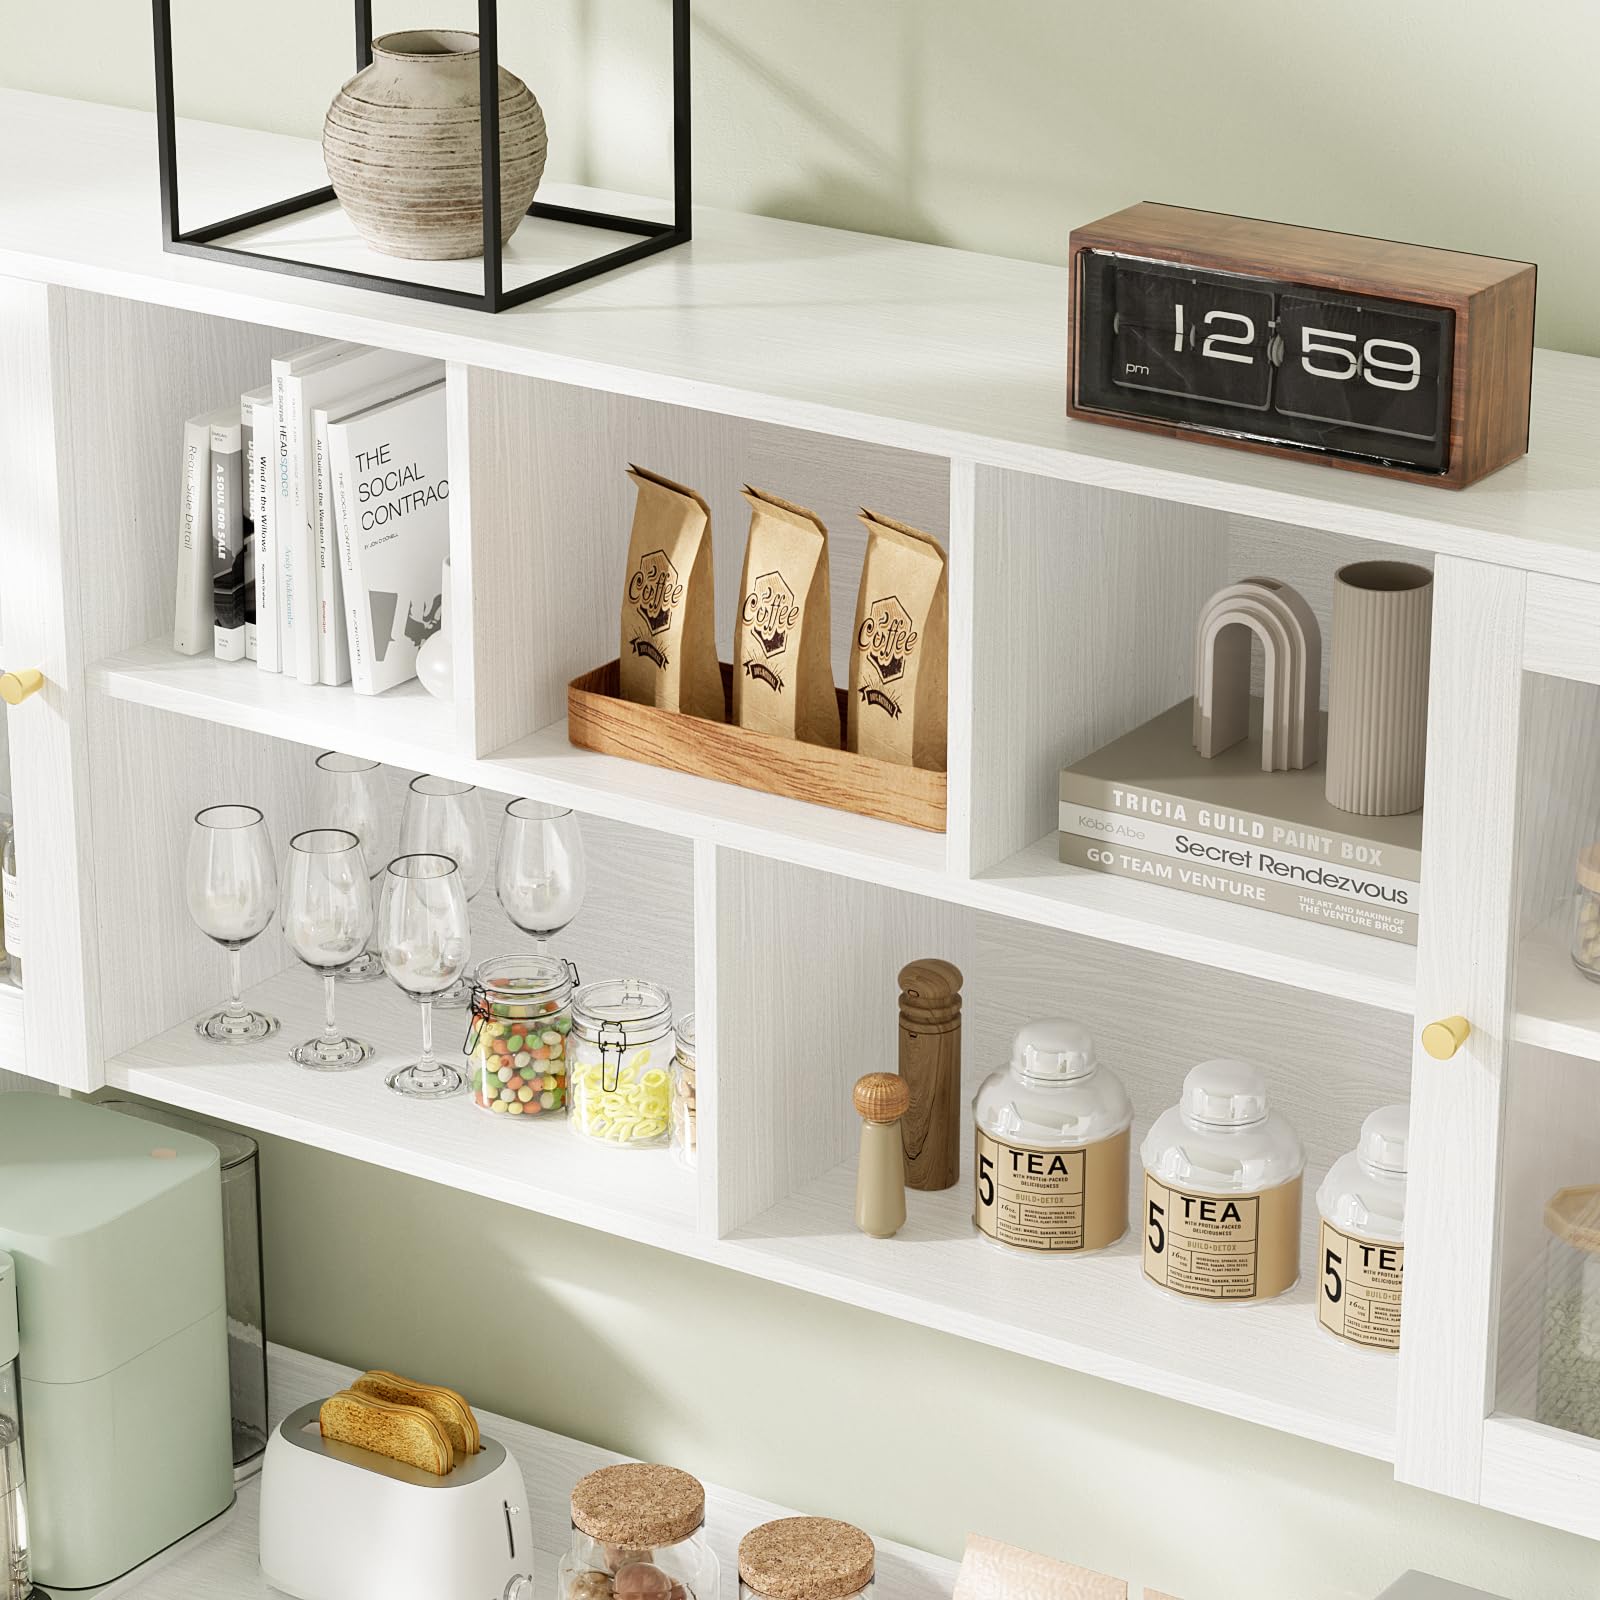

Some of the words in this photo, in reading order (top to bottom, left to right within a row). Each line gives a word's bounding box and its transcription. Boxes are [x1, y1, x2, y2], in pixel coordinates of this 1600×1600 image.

[1174, 304, 1255, 364] 12
[1302, 326, 1420, 391] 59
[1126, 362, 1150, 375] pm
[217, 464, 224, 474] A
[355, 443, 391, 472] THE
[186, 483, 194, 510] Side
[260, 484, 266, 493] in
[318, 479, 323, 490] on
[359, 463, 425, 502] SOCIAL
[184, 514, 194, 550] Detail
[218, 532, 226, 560] SALE
[629, 571, 682, 609] Coffee
[742, 593, 799, 631] Coffee
[858, 618, 918, 656] Coffee
[1112, 790, 1186, 822] TRICIA
[1198, 810, 1264, 838] GUILD
[1272, 826, 1332, 854] PAINT
[1341, 842, 1382, 866] BOX
[1116, 825, 1146, 840] Abe
[1086, 848, 1114, 865] GO
[1120, 855, 1172, 879] TEAM
[1178, 868, 1266, 902] VENTURE
[1176, 835, 1253, 868] Secret
[1259, 854, 1408, 904] Rendezvous
[1299, 896, 1314, 904] THE
[1316, 900, 1333, 908] ART
[1336, 904, 1354, 914] AND
[1299, 903, 1320, 914] THE
[1322, 909, 1372, 927] VENTURE
[1375, 921, 1403, 934] BROS
[1009, 1150, 1068, 1176] TEA
[979, 1153, 994, 1206] 5
[1181, 1197, 1241, 1222] TEA
[1148, 1200, 1164, 1254] 5
[1188, 1241, 1237, 1251] BUILD+DETOX
[1359, 1245, 1403, 1271] TE
[1324, 1248, 1342, 1303] 5
